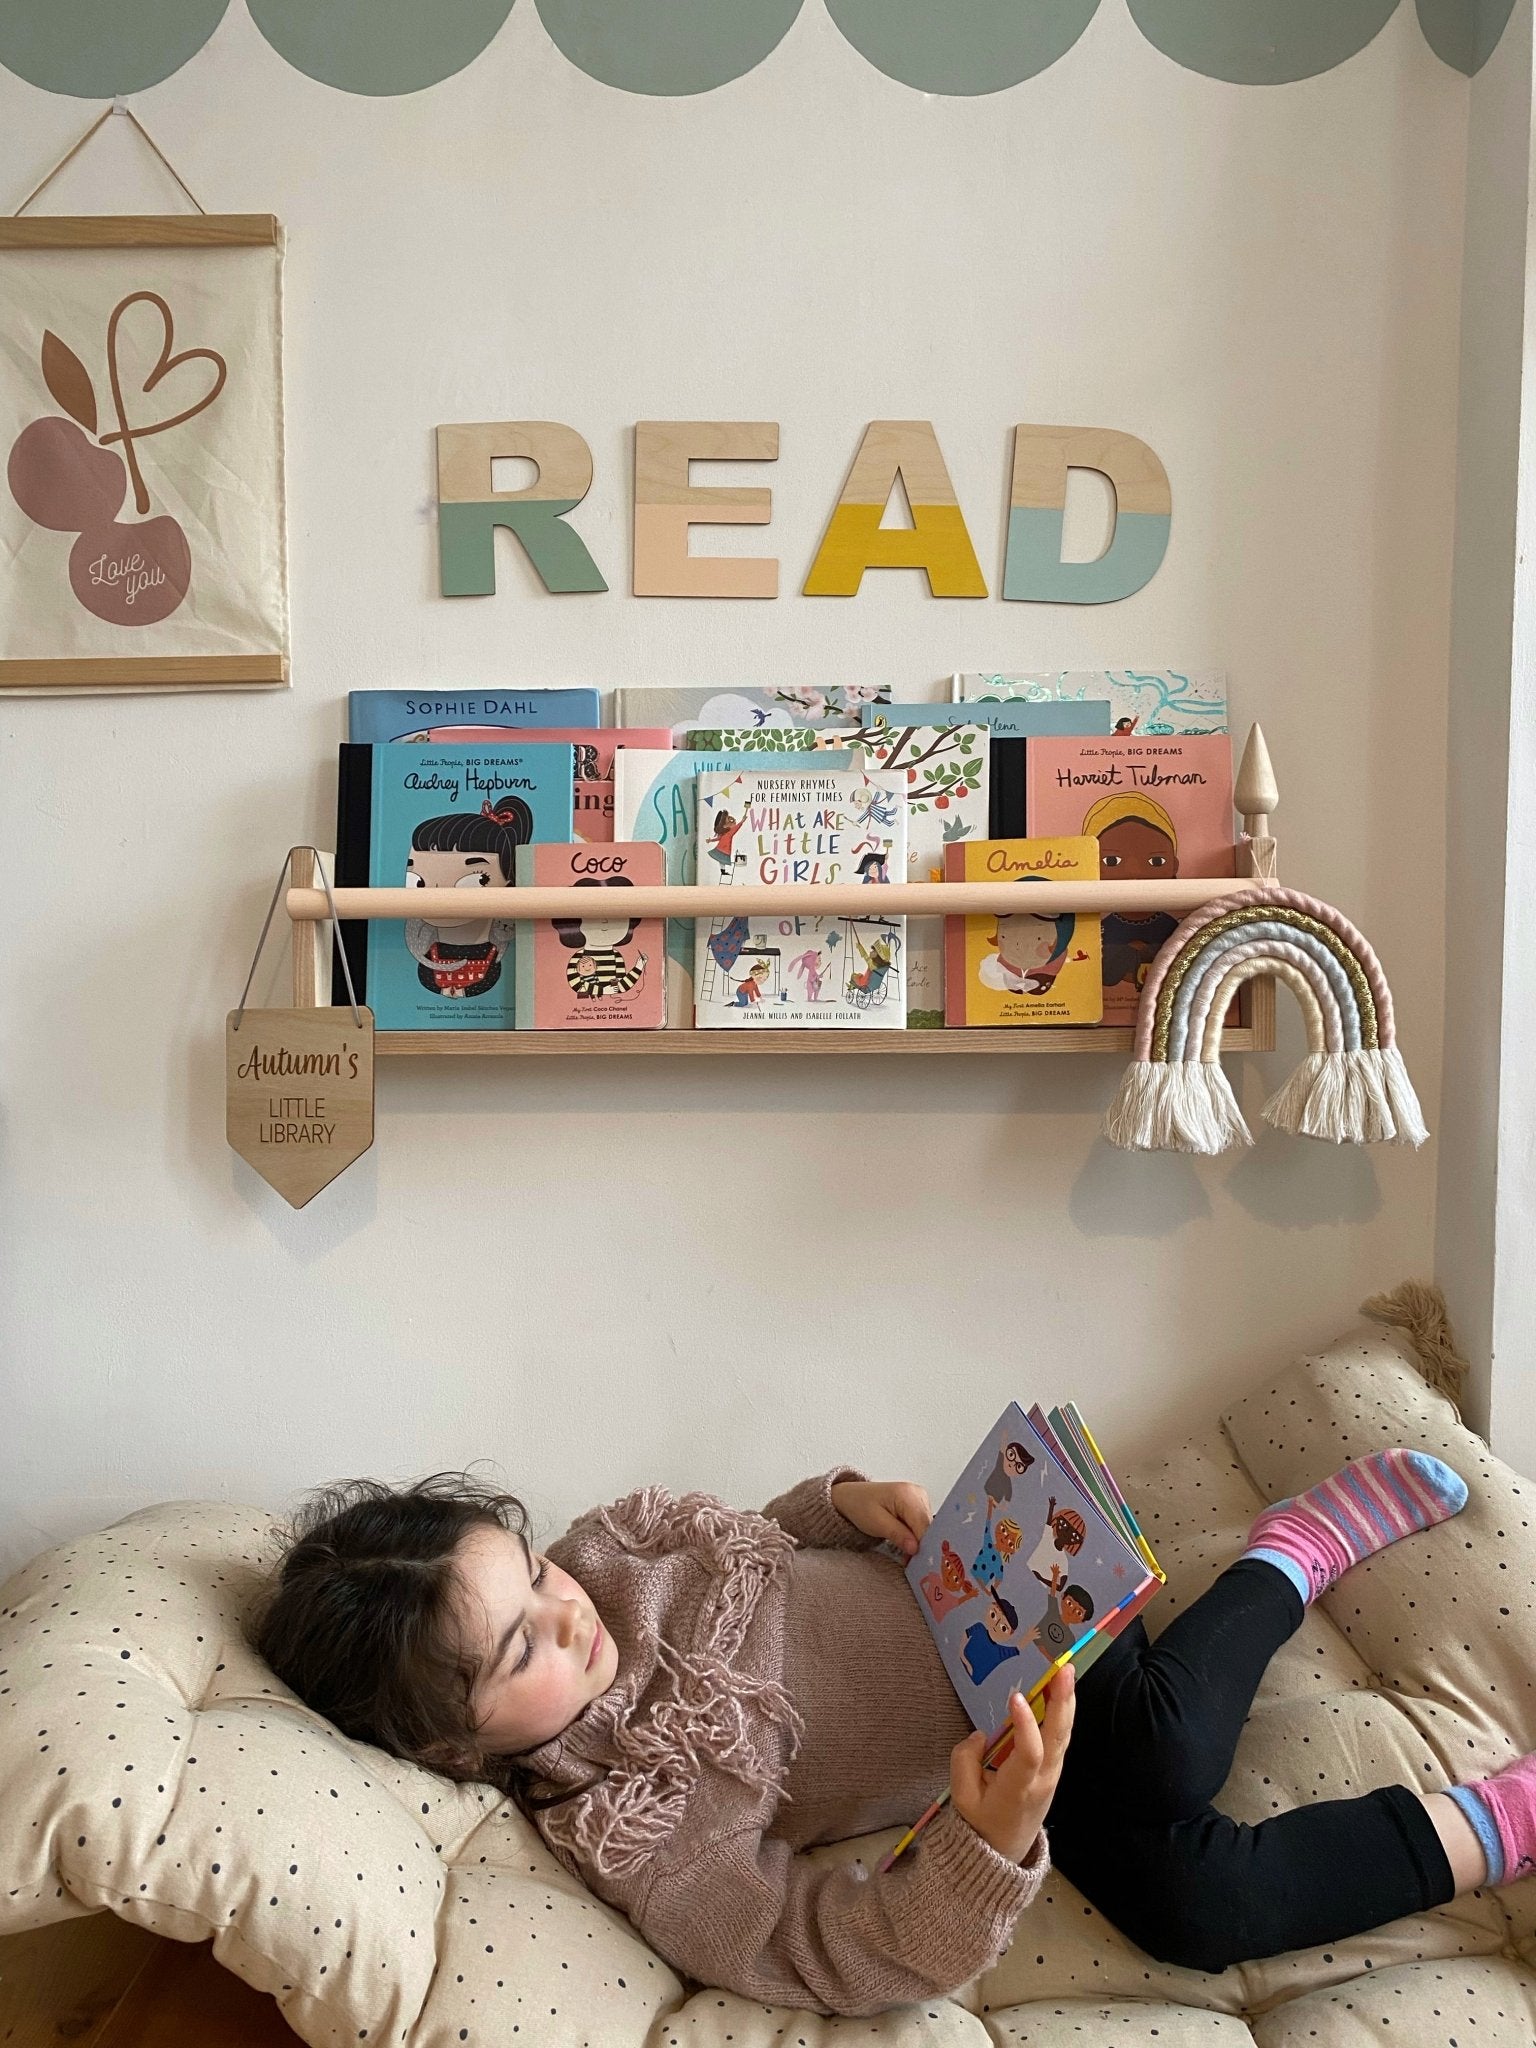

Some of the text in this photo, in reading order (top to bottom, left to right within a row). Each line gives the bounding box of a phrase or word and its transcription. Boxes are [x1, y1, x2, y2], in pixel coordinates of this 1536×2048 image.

[436, 420, 1172, 605] READ
[89, 554, 145, 586] Love
[126, 566, 166, 604] you
[406, 700, 538, 715] SOPHIE DAHL
[420, 758, 439, 766] Little
[465, 758, 481, 766] BIG
[1080, 748, 1099, 756] Little
[1146, 747, 1183, 755] DREAMS
[404, 768, 537, 802] Audrey Hepburn
[757, 779, 836, 790] NURSERY RHYMES
[1056, 763, 1207, 788] Harriet Tubman
[750, 791, 843, 802] FOR FEMINIST TIMES
[813, 808, 844, 830] ARE
[571, 852, 627, 873] Coco
[986, 850, 1079, 873] Amelia
[742, 1012, 765, 1020] JEANNE
[768, 1012, 788, 1020] WILLIS
[790, 1012, 803, 1020] AND
[806, 1012, 832, 1020] ISABELLE
[237, 1042, 359, 1081] Autumn's
[269, 1098, 325, 1118] LITTLE
[259, 1123, 336, 1144] LIBRARY
